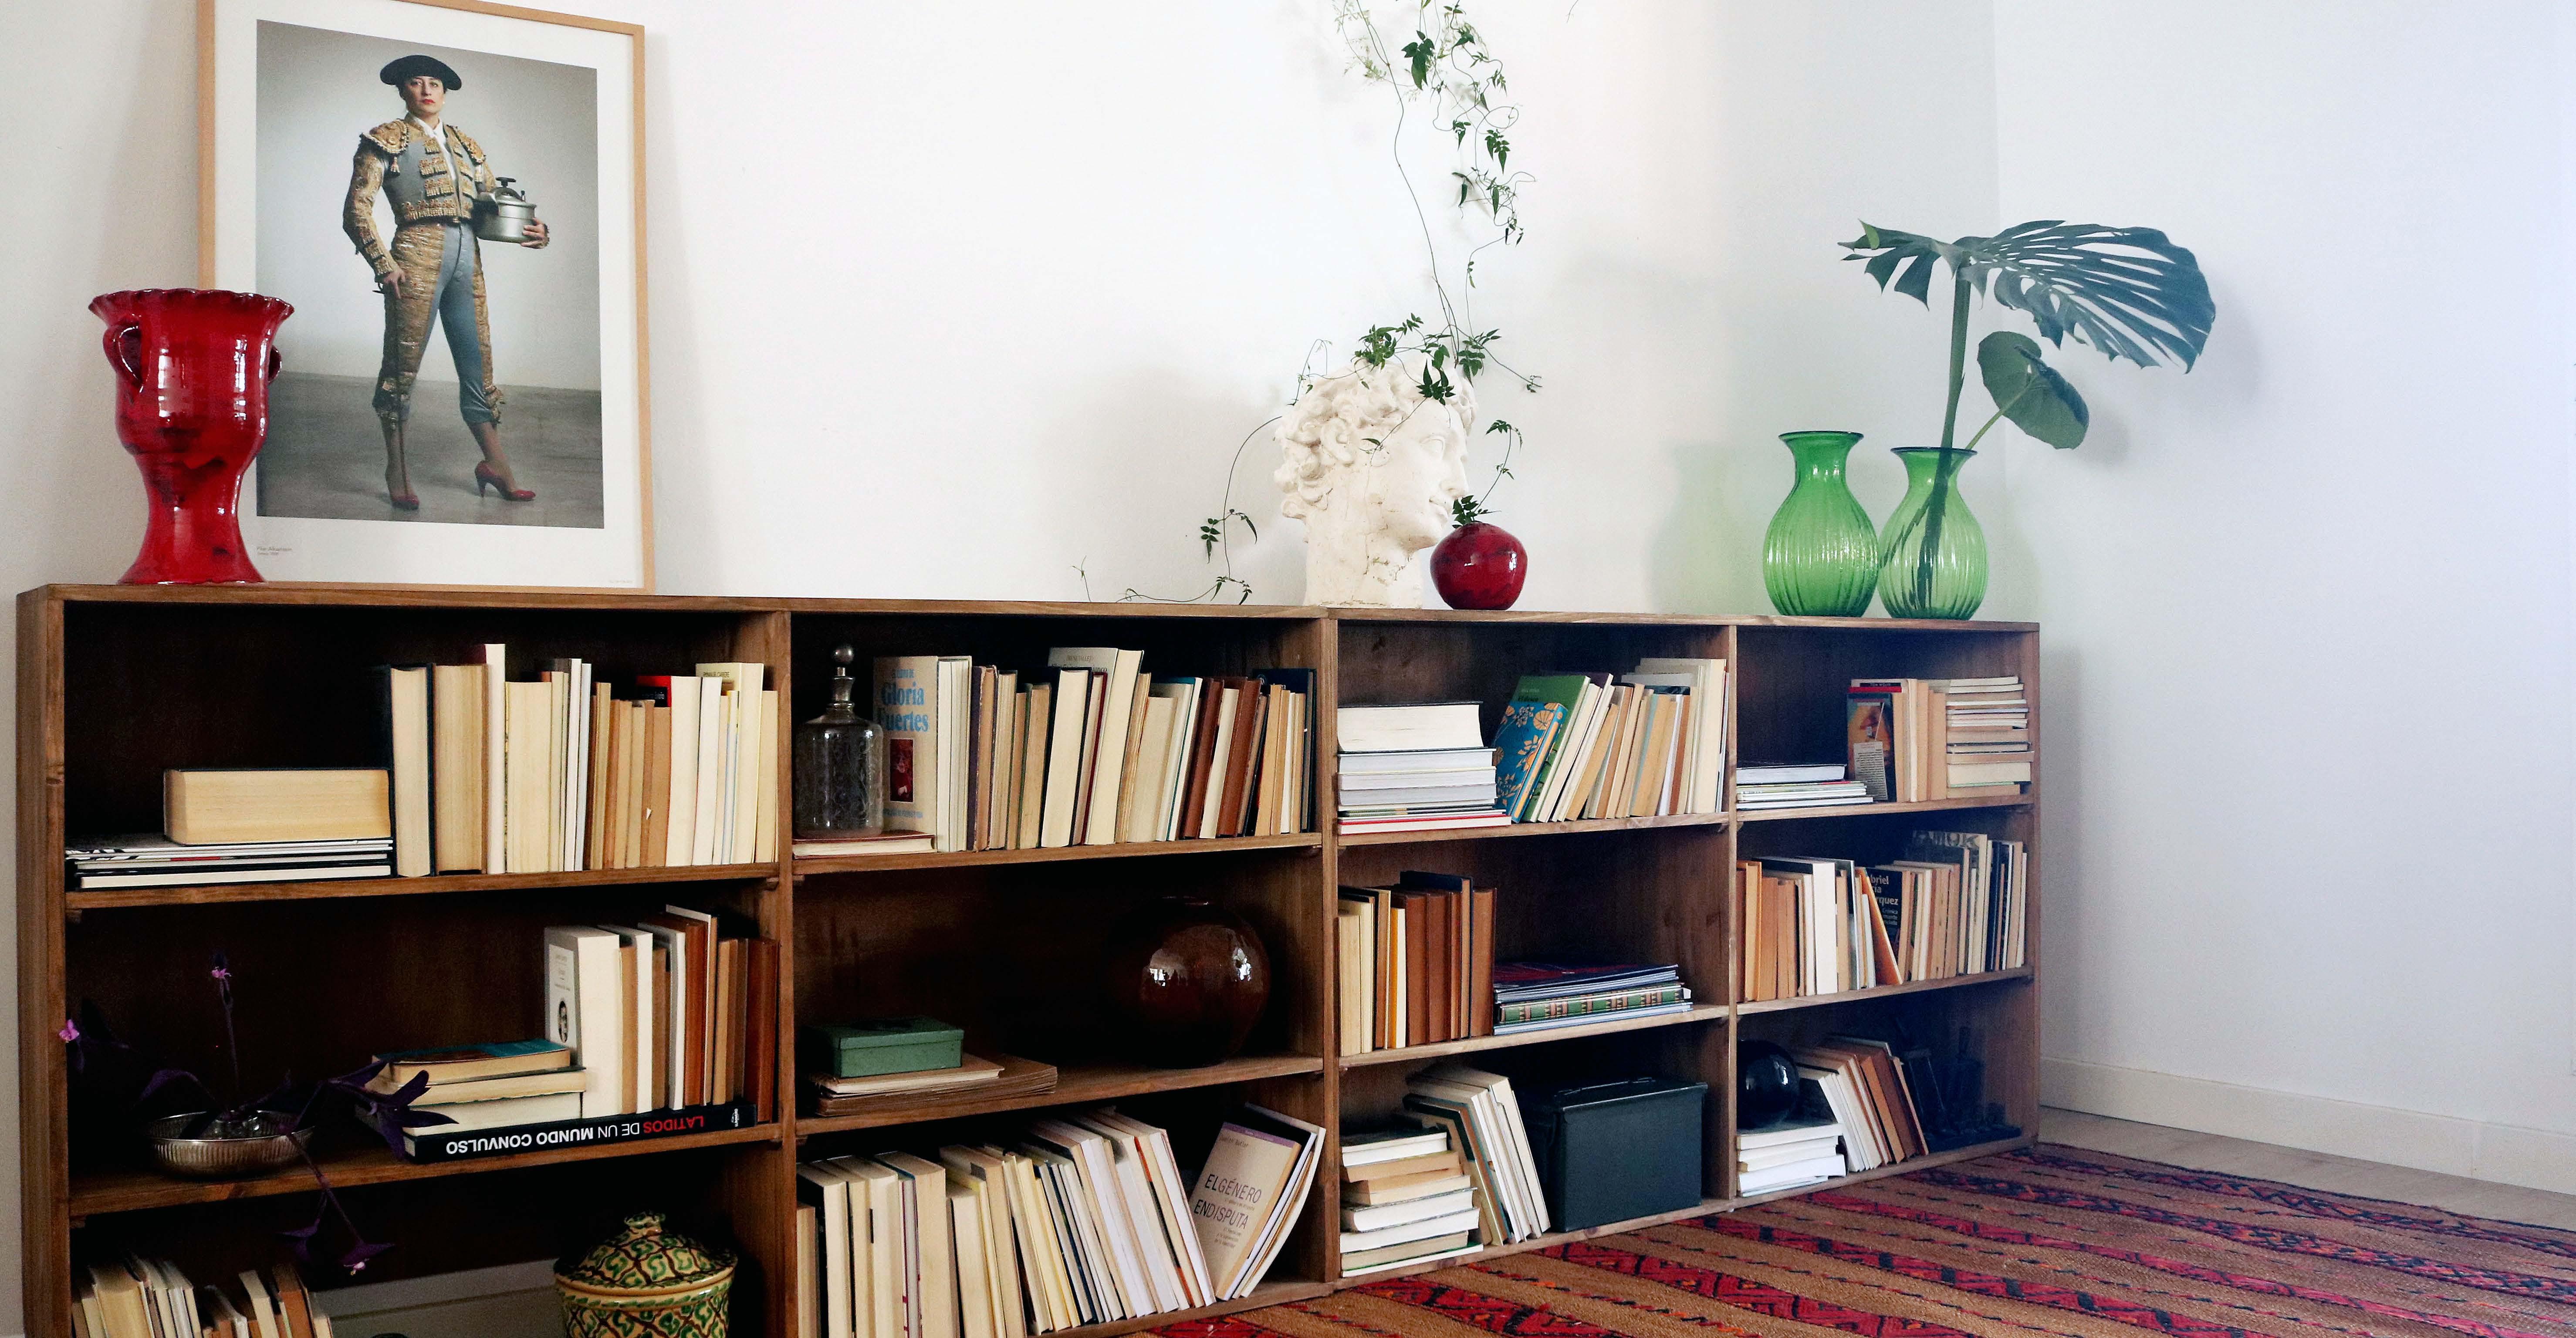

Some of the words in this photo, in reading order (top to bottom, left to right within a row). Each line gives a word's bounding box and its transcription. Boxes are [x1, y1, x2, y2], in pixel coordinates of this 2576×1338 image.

[882, 681, 924, 705] Gloria
[1870, 874, 1889, 885] briel
[1876, 897, 1899, 906] quez
[598, 1125, 618, 1139] UN
[622, 1122, 640, 1136] DE
[643, 1115, 704, 1133] LATIDOS
[446, 1134, 532, 1154] CONVULSO
[536, 1127, 593, 1145] MUNDO
[1218, 1178, 1262, 1203] GÉNERO
[1206, 1204, 1249, 1230] DISPUTA
